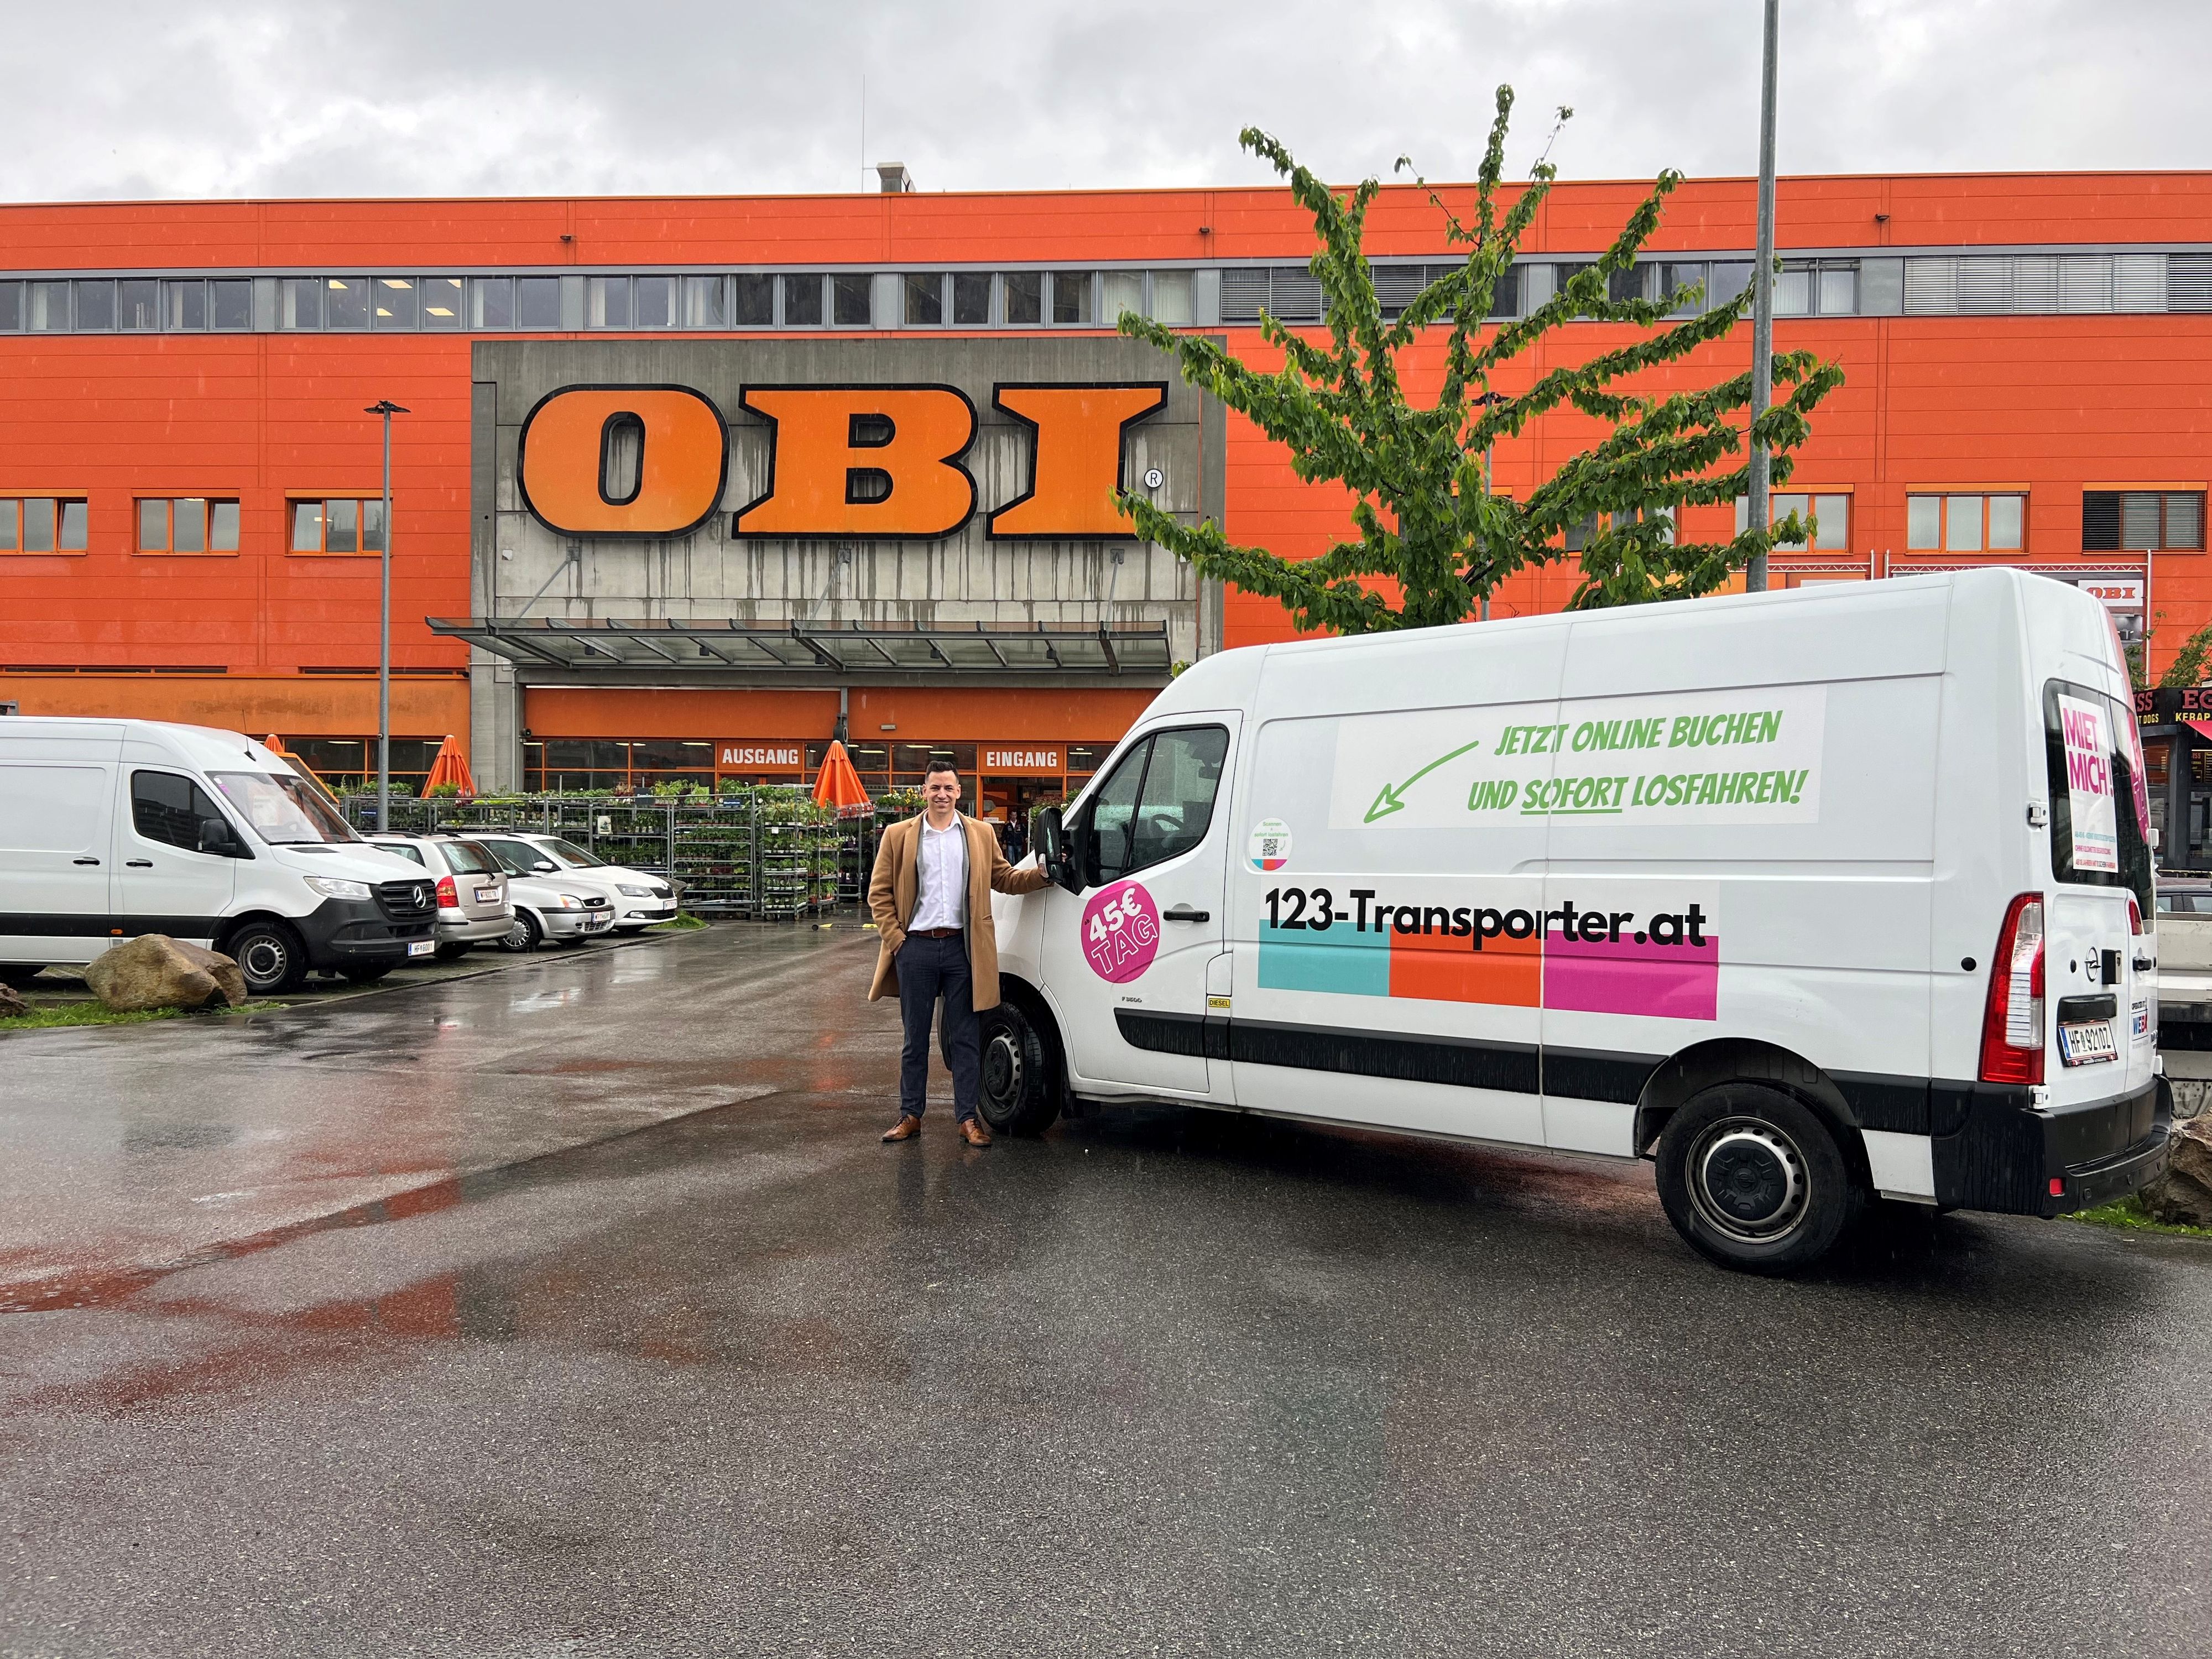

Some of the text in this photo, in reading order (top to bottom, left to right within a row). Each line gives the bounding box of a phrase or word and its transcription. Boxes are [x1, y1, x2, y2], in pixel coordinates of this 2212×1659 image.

[517, 382, 1168, 540] OBI
[2086, 587, 2135, 599] OBI
[1494, 710, 1783, 755] JETZT ONLINE BUCHEN
[2063, 708, 2098, 752] MIET
[2143, 713, 2159, 724] DOGS
[2176, 712, 2211, 722] KEBAP
[722, 748, 799, 764] AUSGANG
[987, 752, 1057, 767] EINGANG
[1468, 769, 1809, 811] UND SOFORT LOSFAHREN!
[1089, 888, 1142, 942] 45€
[1265, 887, 1707, 951] 123-Transporter.at
[1091, 914, 1158, 974] TAG
[2068, 1030, 2080, 1053] HF
